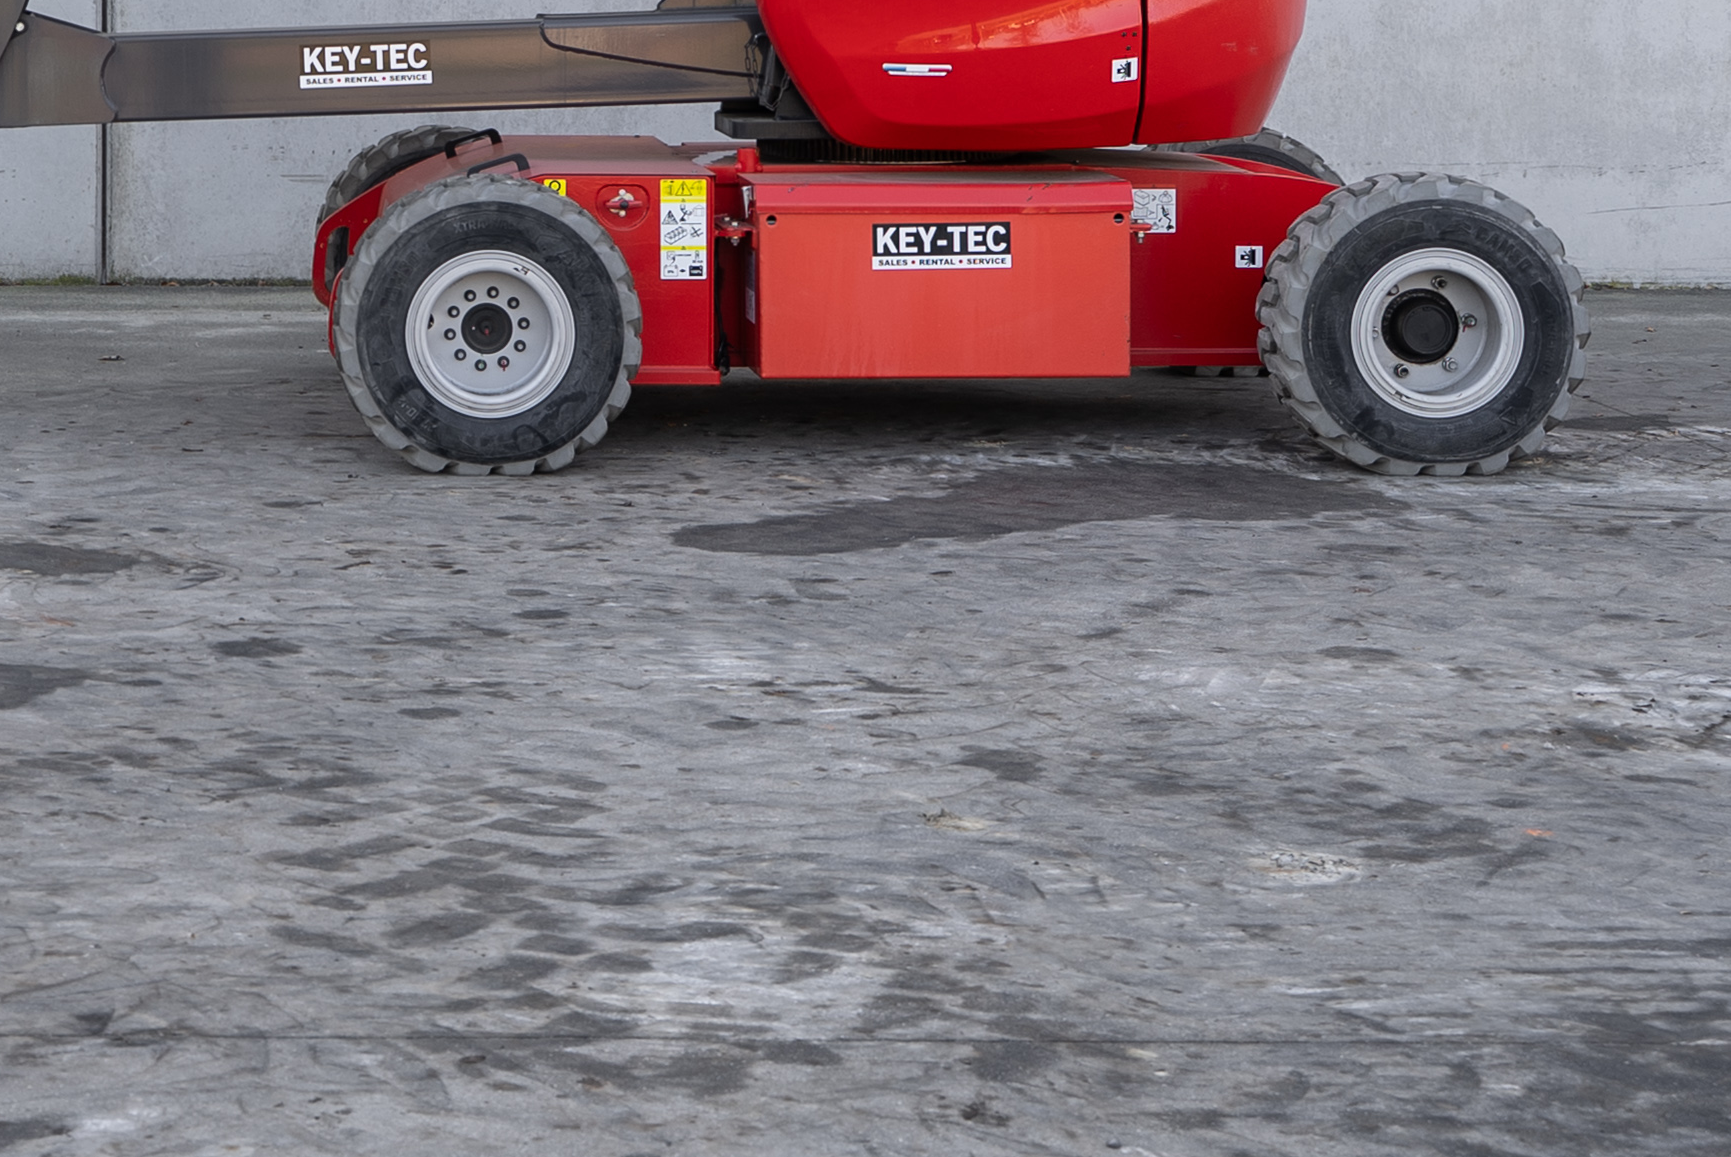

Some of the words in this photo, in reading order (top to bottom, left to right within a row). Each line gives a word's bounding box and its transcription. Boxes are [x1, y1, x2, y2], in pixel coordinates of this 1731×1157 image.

[303, 42, 428, 74] KEY-TEC
[306, 77, 335, 85] SALES
[389, 73, 428, 82] SERVICE
[876, 225, 1008, 254] KEY-TEC
[878, 259, 908, 267] SALES
[919, 258, 956, 266] RENTAL
[966, 257, 1007, 265] SERVICE
